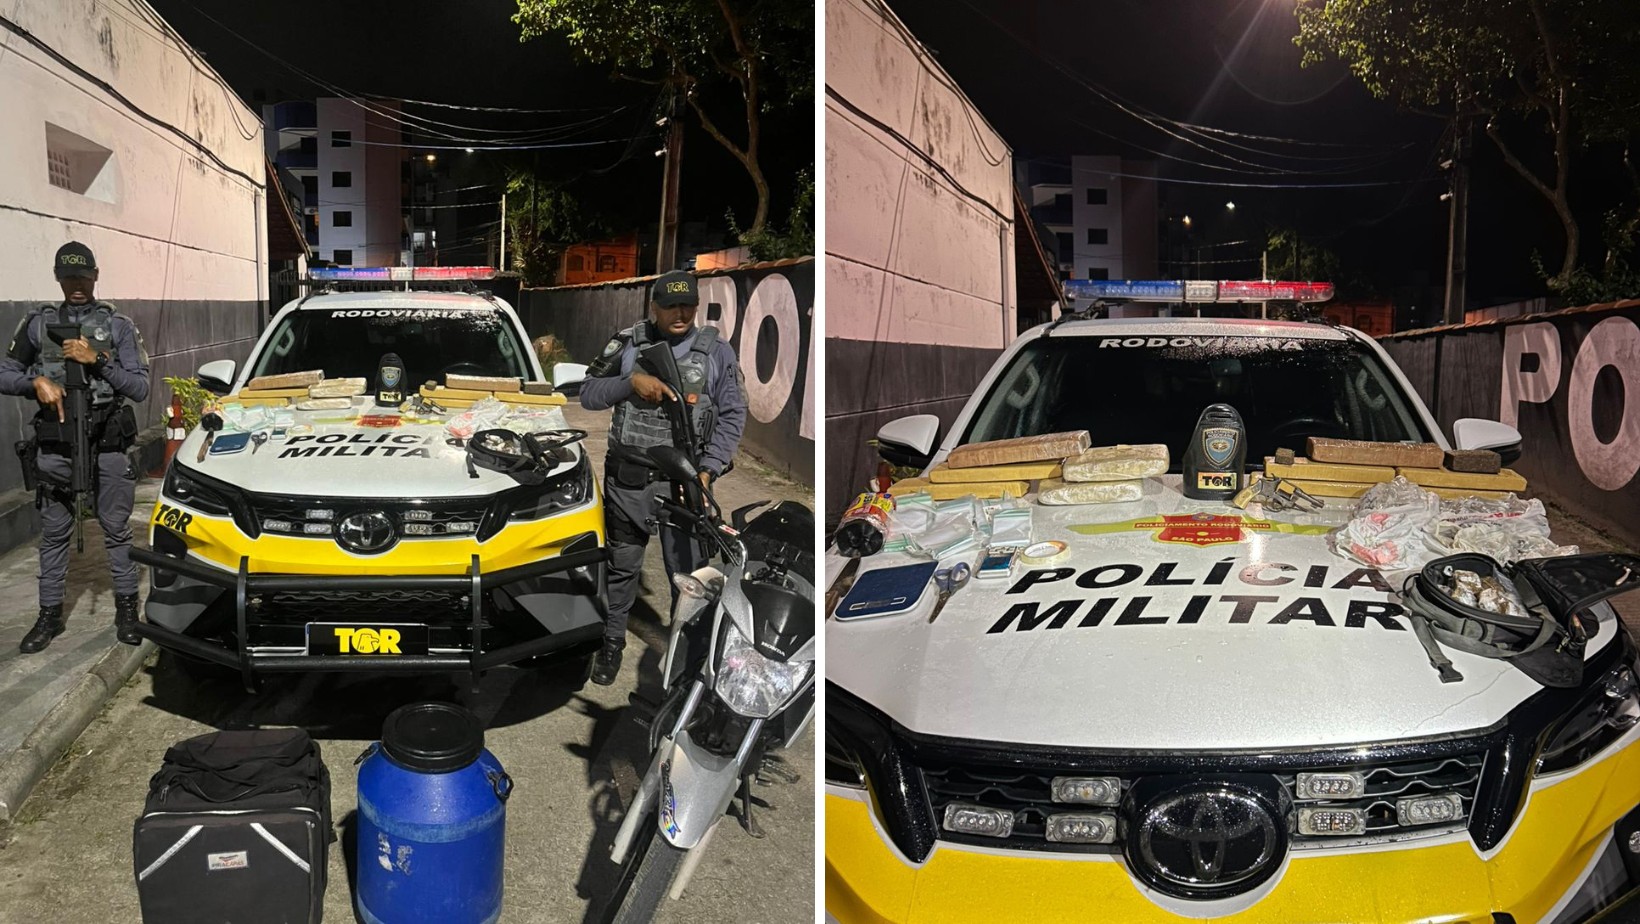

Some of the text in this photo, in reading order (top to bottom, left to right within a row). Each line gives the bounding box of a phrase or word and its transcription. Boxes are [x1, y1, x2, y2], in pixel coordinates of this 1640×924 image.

[61, 254, 87, 265] TOR
[666, 281, 690, 293] TOR
[1202, 475, 1232, 486] TOR
[155, 503, 193, 534] TOR
[1004, 556, 1396, 595] POLÍCIA
[985, 594, 1408, 635] MILITAR
[334, 627, 403, 654] TOR
